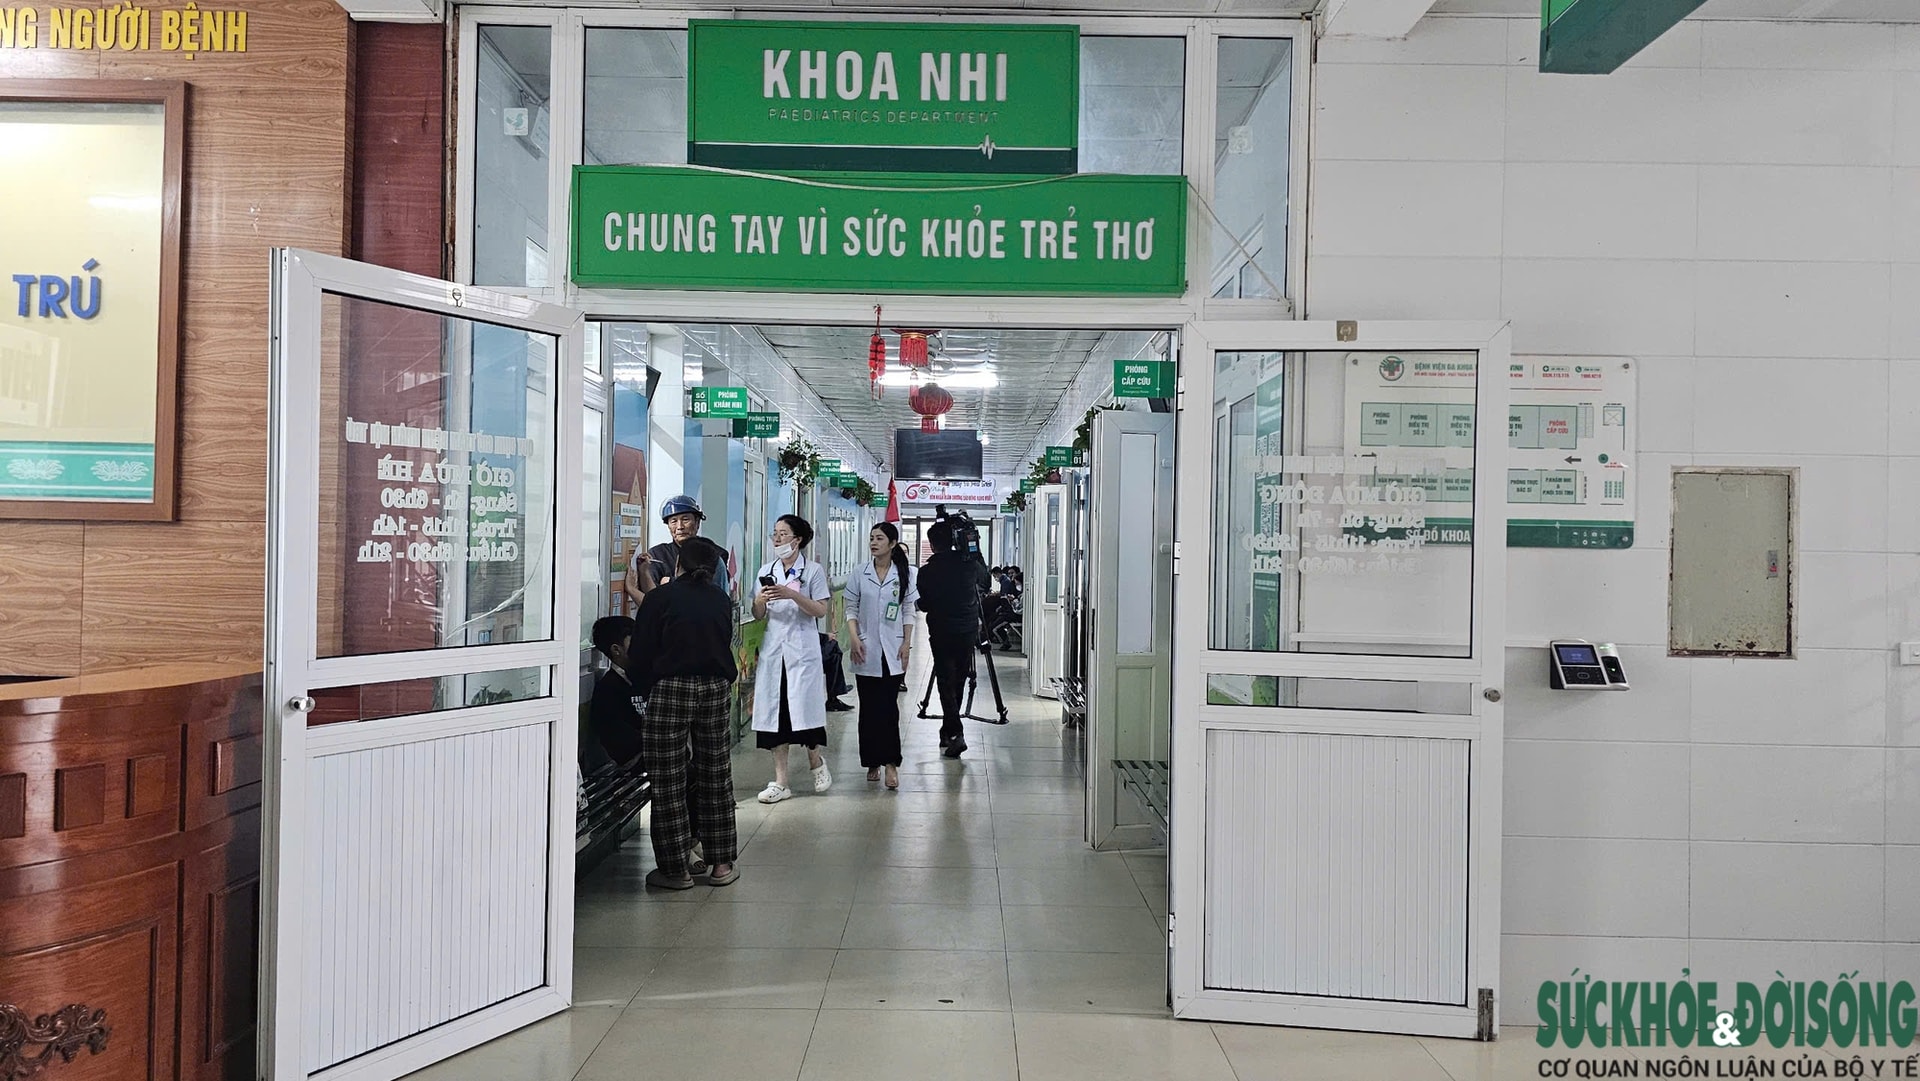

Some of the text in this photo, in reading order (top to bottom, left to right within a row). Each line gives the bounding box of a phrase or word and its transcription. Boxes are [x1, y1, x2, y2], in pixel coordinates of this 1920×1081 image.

[50, 1, 150, 51] NGƯỜI
[161, 2, 248, 60] BỆNH
[762, 49, 1008, 102] KHOA NHI
[768, 107, 999, 124] PAEDIATRICS DEPARTMENT
[604, 204, 1155, 260] CHUNG TAY VÌ SỨC KHỎE TRẺ THƠ
[12, 257, 102, 320] TRÚ
[1125, 364, 1148, 373] PHÒNG
[1121, 375, 1151, 386] CẤP CỨU
[694, 401, 707, 413] 80
[1073, 456, 1082, 465] 01
[1441, 529, 1471, 543] KHOA
